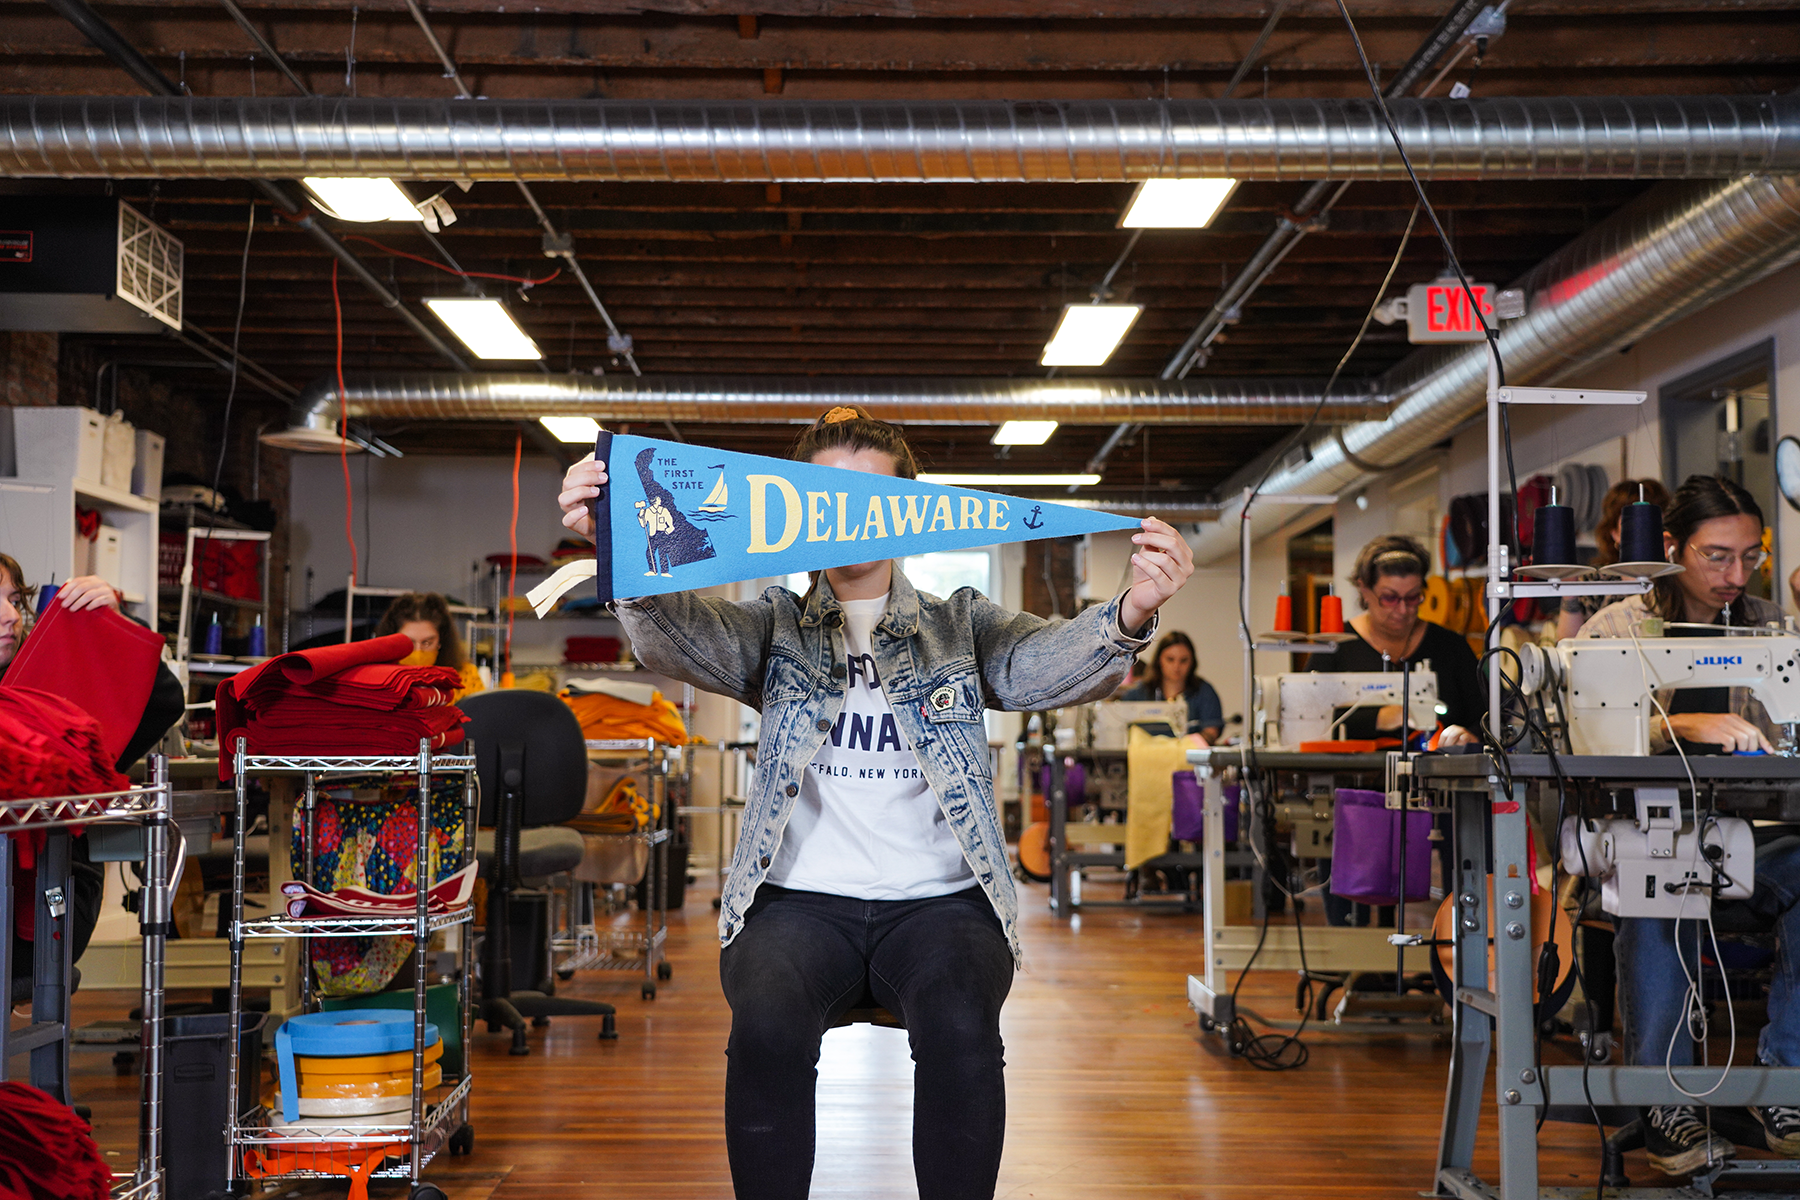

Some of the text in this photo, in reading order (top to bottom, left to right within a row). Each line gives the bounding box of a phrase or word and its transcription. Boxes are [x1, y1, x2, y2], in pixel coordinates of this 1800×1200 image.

[1427, 286, 1487, 332] EXIT
[657, 458, 677, 466] THE
[664, 469, 694, 478] FIRST
[672, 481, 704, 490] STATE
[746, 474, 1010, 554] DELAWARE
[1695, 656, 1742, 665] JUKI
[859, 768, 885, 779] NEW
